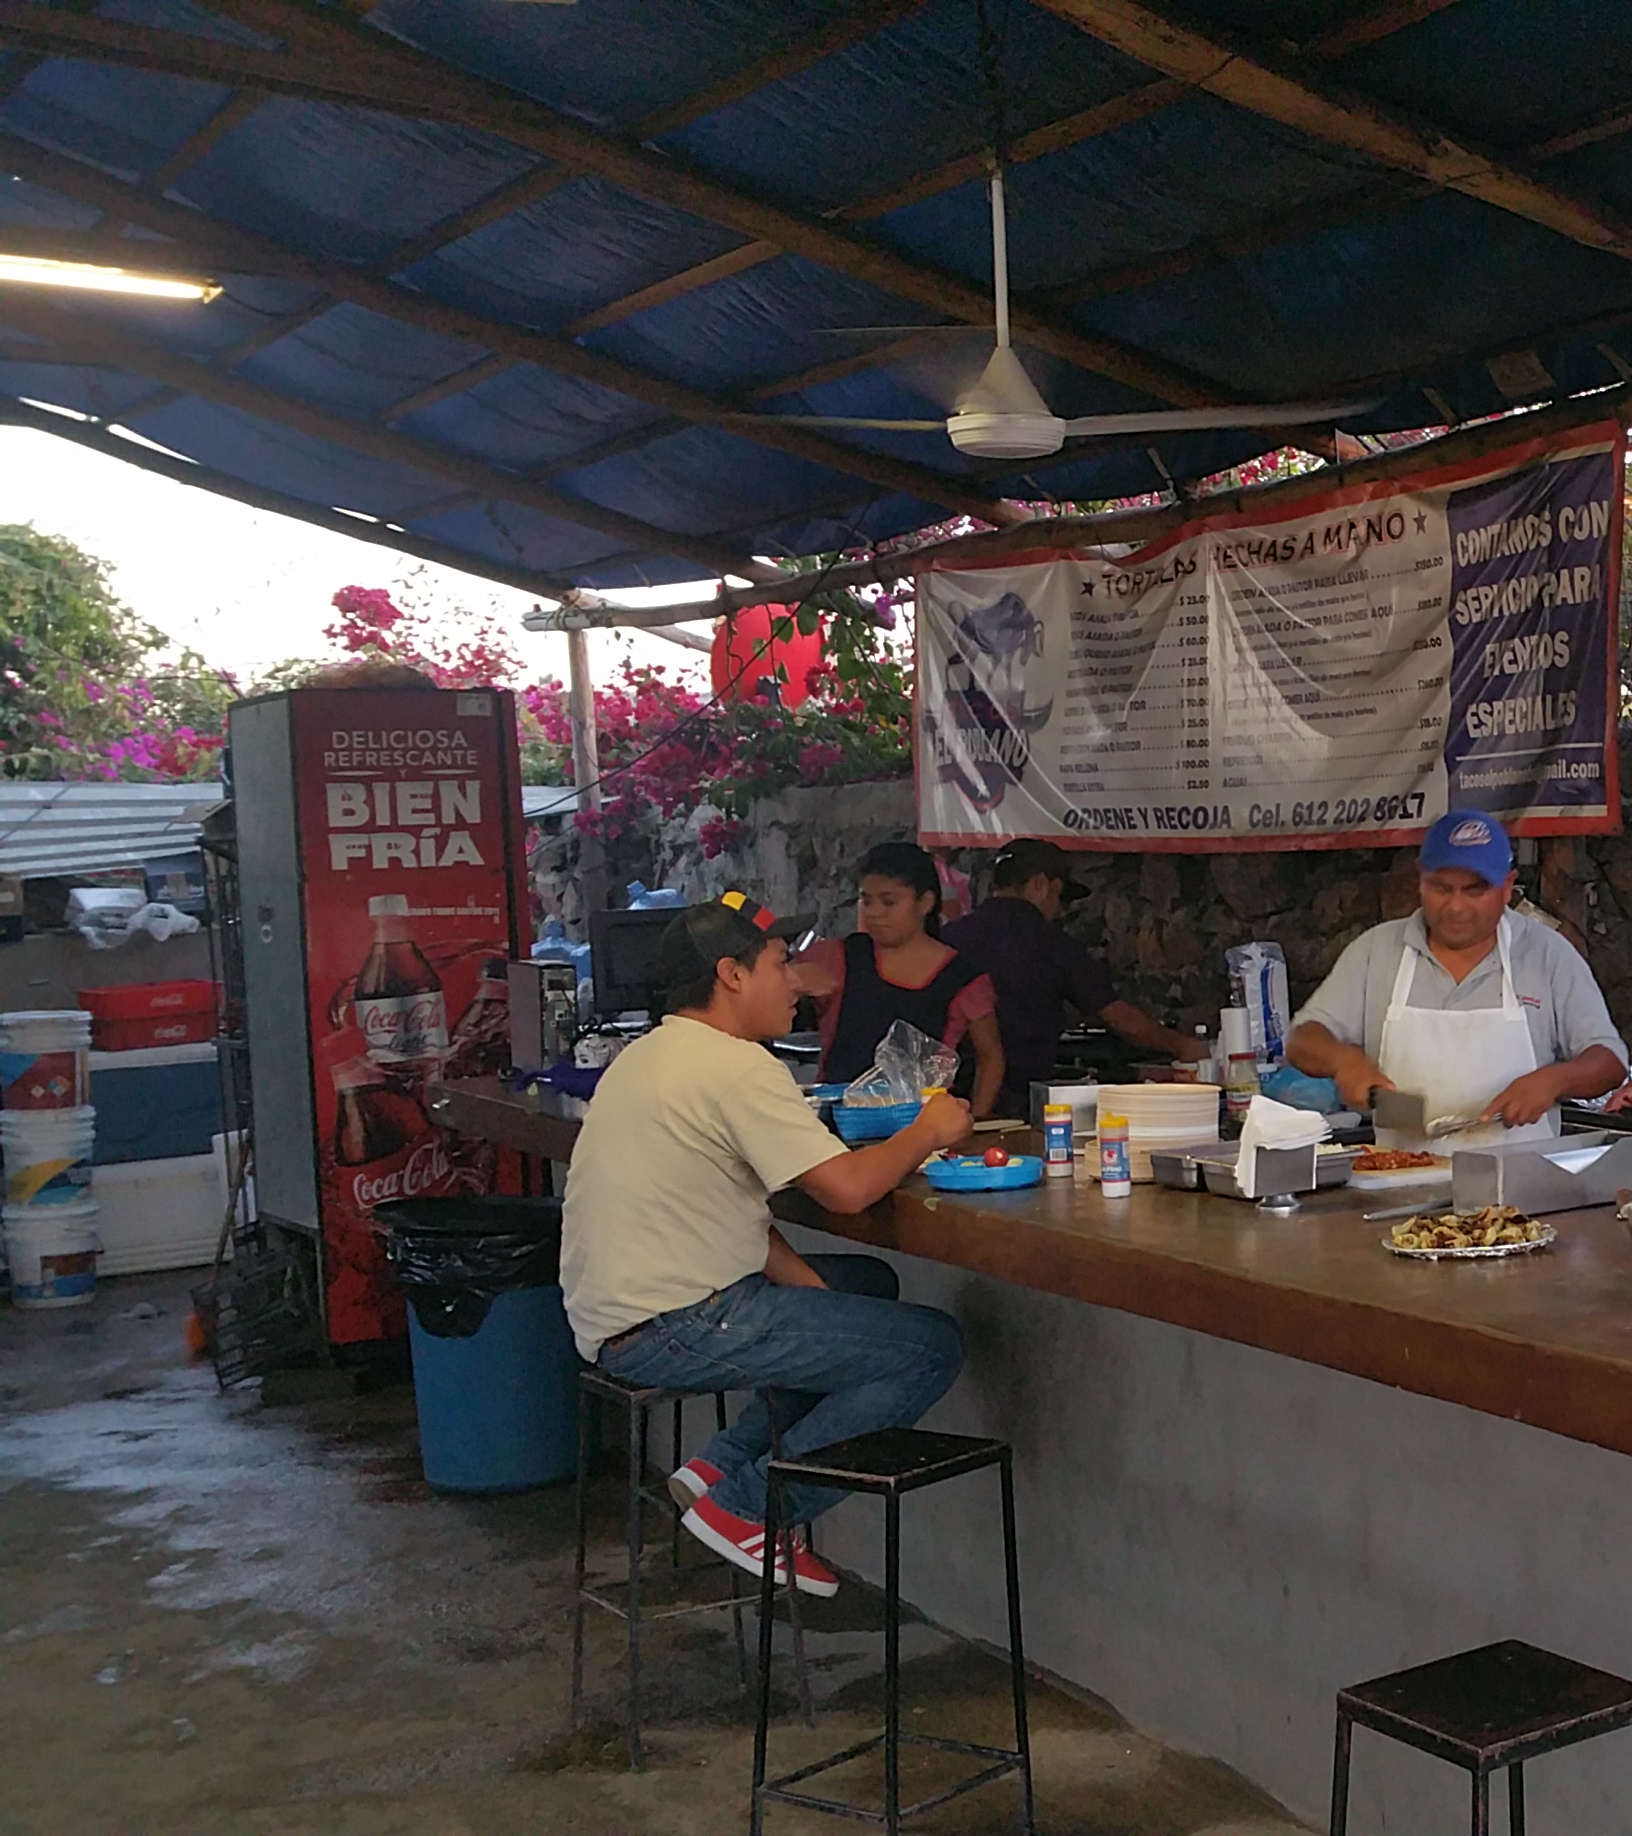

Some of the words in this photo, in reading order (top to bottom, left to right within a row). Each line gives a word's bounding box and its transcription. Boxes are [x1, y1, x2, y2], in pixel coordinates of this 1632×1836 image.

[1211, 536, 1296, 570] HECHAS
[1300, 531, 1315, 557] A
[1323, 512, 1405, 552] MANO
[1456, 510, 1552, 567] CONTAMOS
[1558, 501, 1609, 543] CON
[1455, 575, 1539, 626] SERVICIO
[1541, 566, 1600, 608] PARA
[1483, 631, 1570, 678] EVENTOS
[1466, 690, 1576, 739] ESPECIALES
[324, 750, 478, 767] REFRESCANTE
[332, 730, 468, 749] DELICIOSA
[399, 769, 407, 778] Y
[326, 780, 481, 827] BIEN
[1063, 807, 1137, 830] ORDENE
[1137, 807, 1150, 830] Y
[1152, 805, 1232, 830] RECOJA
[1249, 803, 1285, 828] Cel.
[1292, 800, 1329, 827] 612
[1333, 798, 1371, 825] 202
[1373, 792, 1426, 822] 8617
[327, 828, 485, 871] FRÍA
[353, 1137, 451, 1208] Coca-Cola
